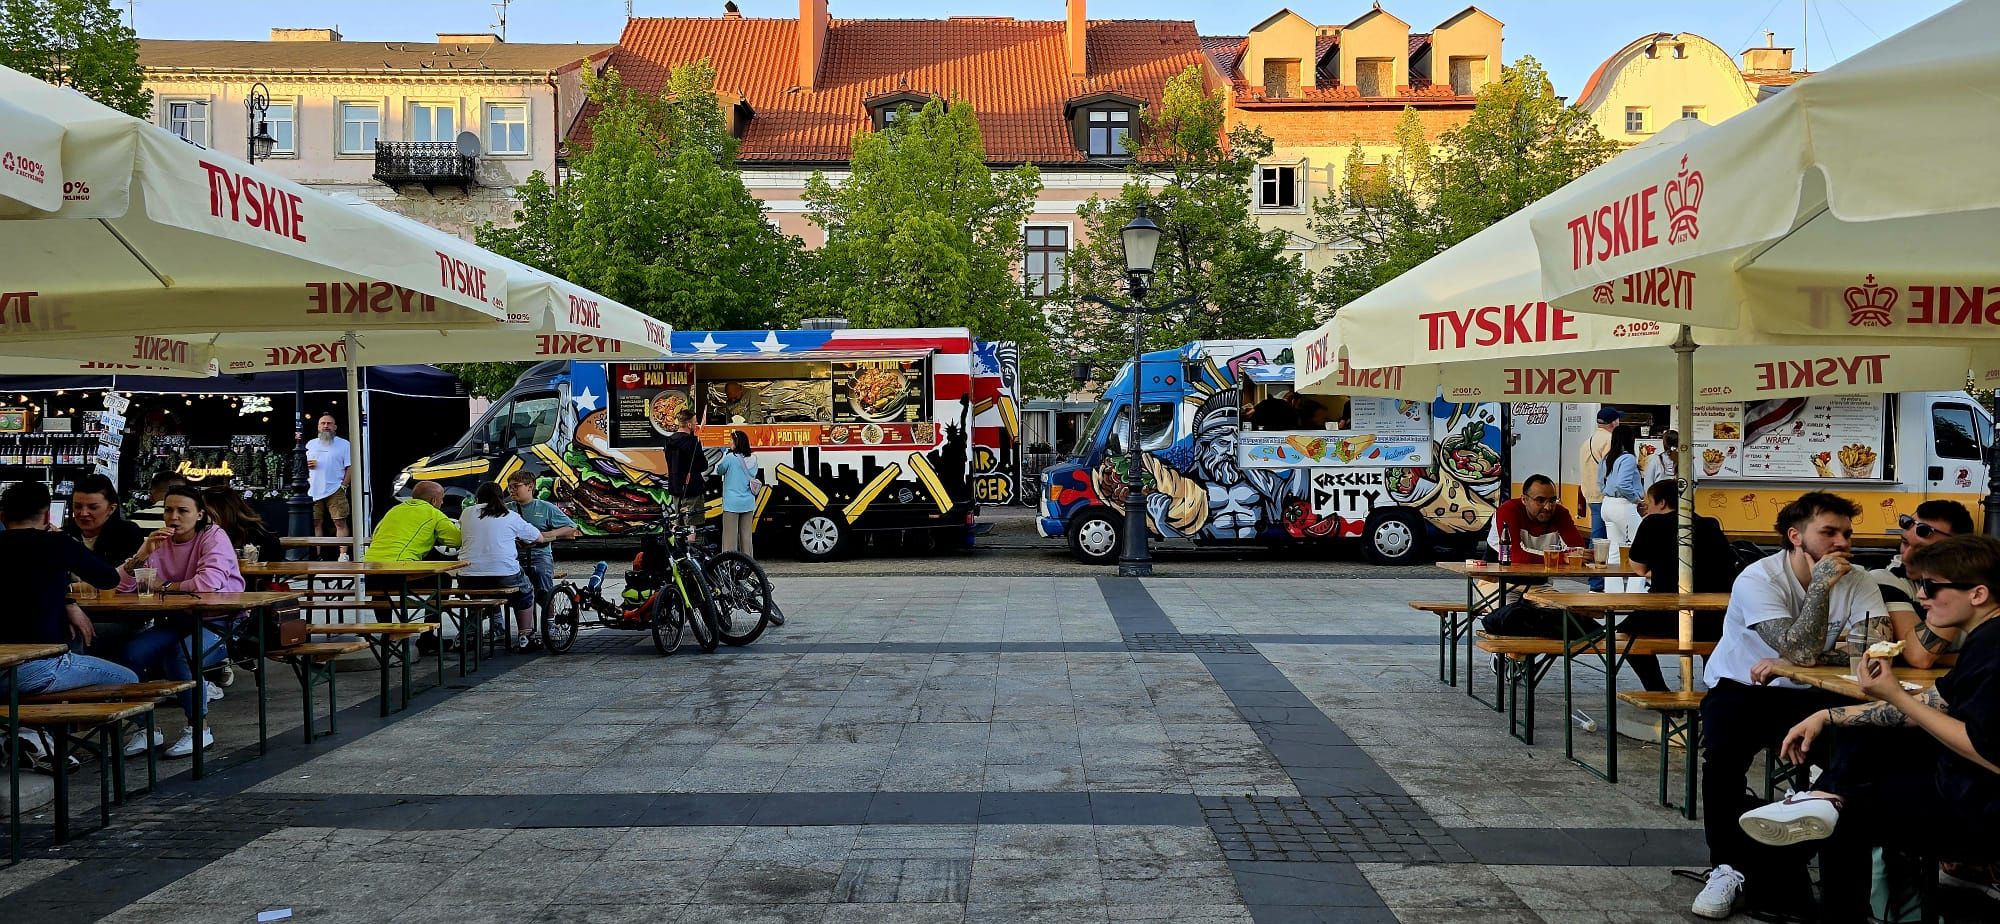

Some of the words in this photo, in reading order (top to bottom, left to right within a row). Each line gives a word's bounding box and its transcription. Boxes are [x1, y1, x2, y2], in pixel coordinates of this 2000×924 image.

[17, 156, 44, 177] 100%
[63, 182, 89, 194] 0%
[199, 160, 307, 242] TYSKIE
[1568, 185, 1658, 271] TYSKIE
[435, 250, 487, 303] TYSKIE
[569, 294, 601, 329] TYSKIE
[643, 318, 666, 348] TYSKIE
[1419, 301, 1578, 350] TYSKIE
[1628, 321, 1660, 332] 100%
[1305, 333, 1329, 375] TYSKIE
[644, 372, 664, 385] PAD
[666, 371, 688, 385] THAI
[1512, 402, 1548, 416] Chicken
[777, 431, 792, 442] PAD
[794, 431, 811, 442] THAI
[1765, 436, 1791, 445] WRAPY
[1313, 472, 1382, 489] GRECKIE
[1313, 488, 1381, 511] PITY
